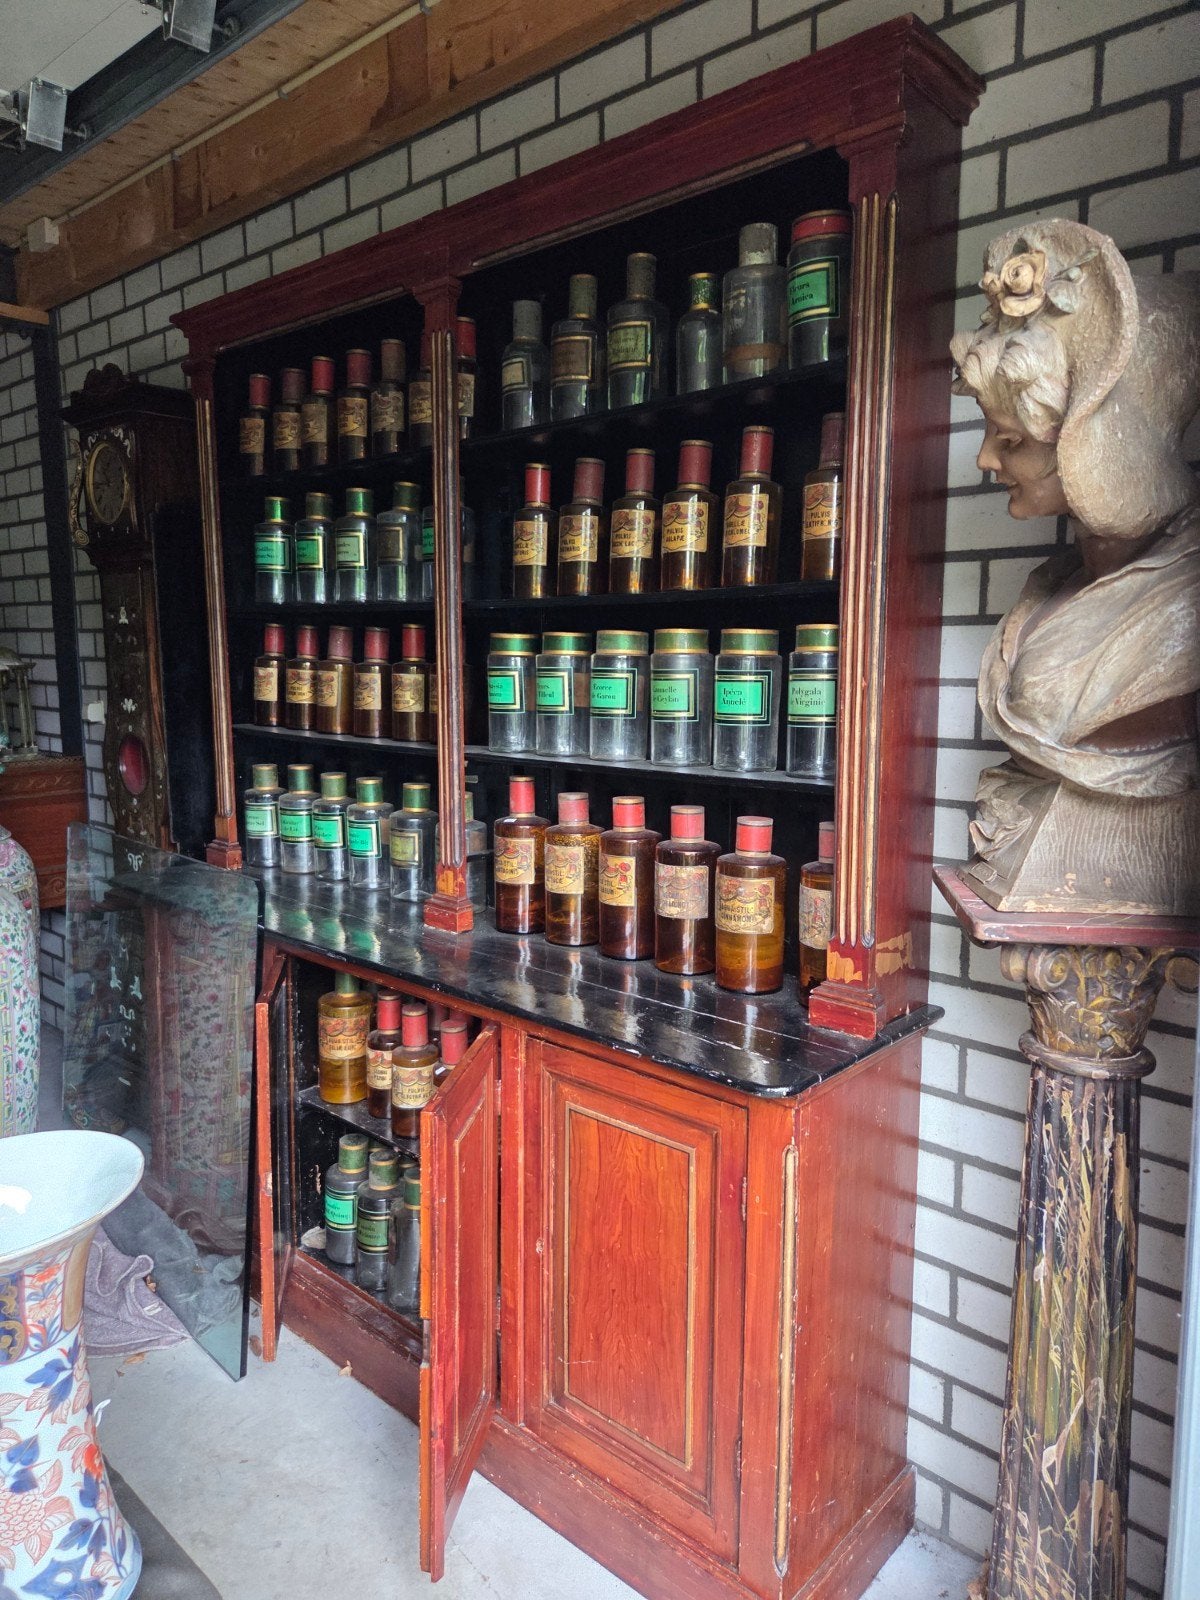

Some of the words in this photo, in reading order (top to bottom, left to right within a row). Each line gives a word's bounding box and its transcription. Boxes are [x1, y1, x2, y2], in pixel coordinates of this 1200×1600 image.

[810, 510, 831, 519] PULVIS
[791, 687, 822, 697] Polygala
[795, 696, 826, 707] Virginie
